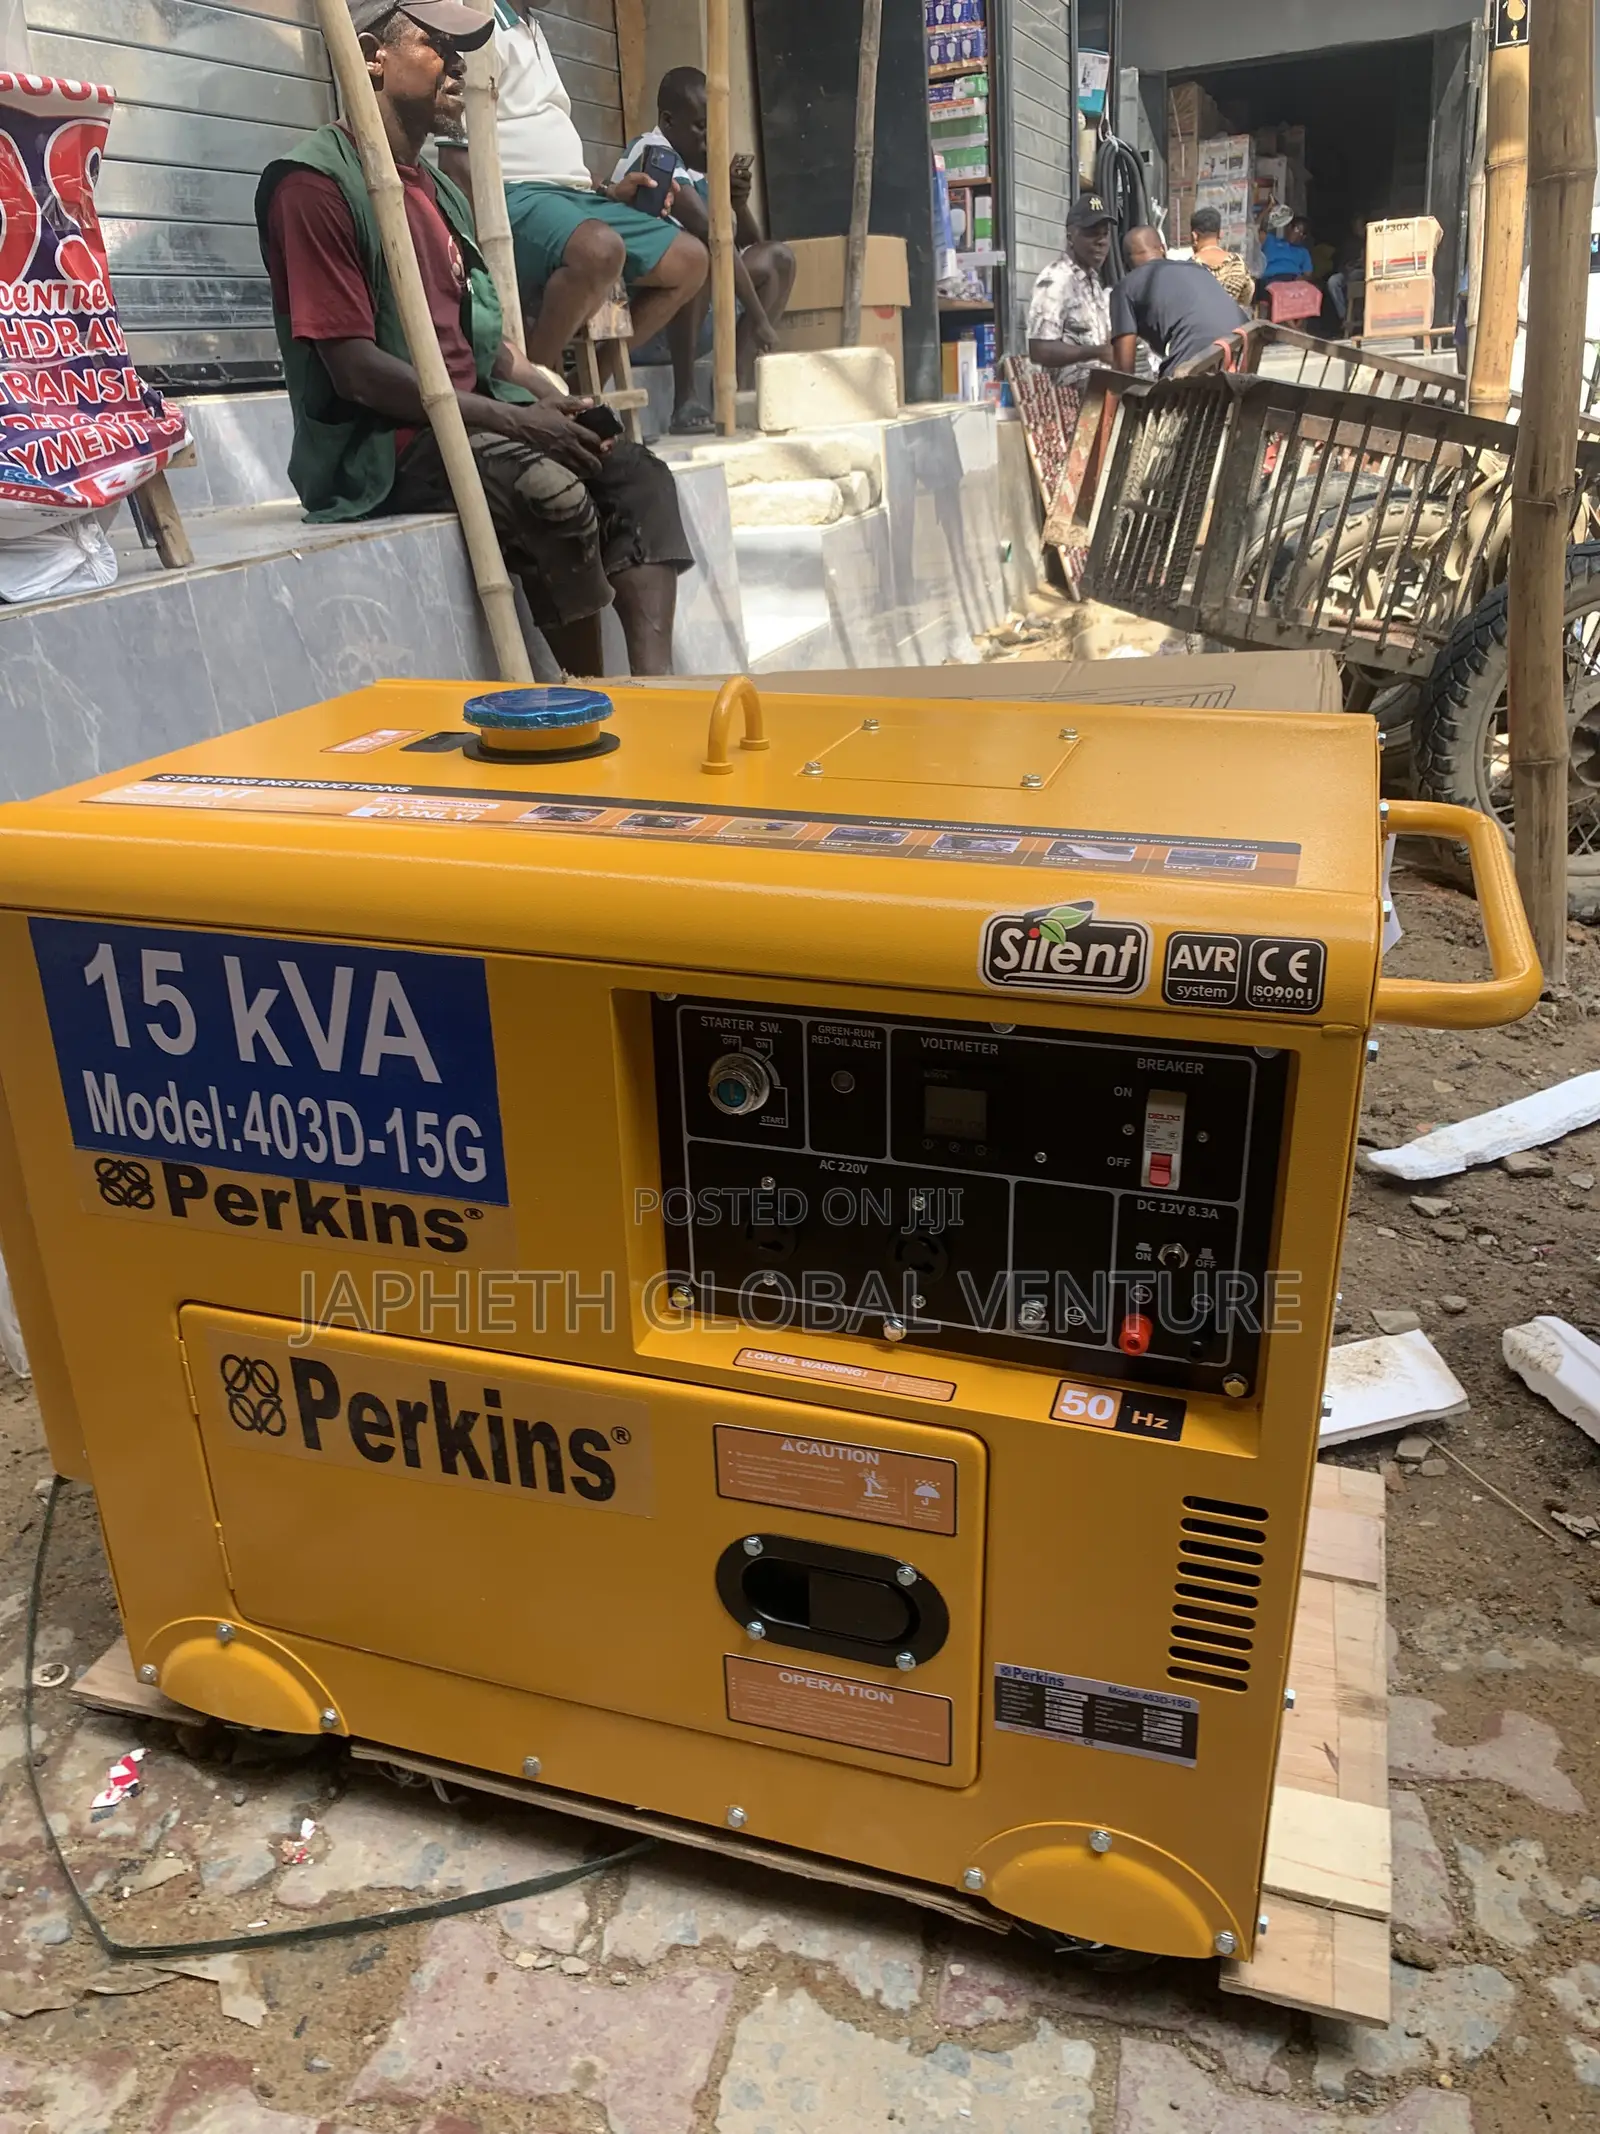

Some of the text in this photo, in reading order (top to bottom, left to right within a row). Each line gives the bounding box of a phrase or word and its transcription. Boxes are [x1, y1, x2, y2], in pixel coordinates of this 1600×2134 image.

[125, 784, 264, 798] SILENT
[158, 775, 412, 793] STARTING INSTRUCTIONS
[993, 926, 1138, 978] Silent
[1170, 944, 1236, 973] AVR
[1257, 946, 1311, 984] CE
[1175, 984, 1228, 1000] system
[1252, 984, 1313, 1001] ISO9001
[83, 942, 443, 1084] 15 kVA
[700, 1015, 783, 1035] STARTER SW.
[817, 1024, 876, 1039] GREEN-RUN
[722, 1036, 738, 1046] OFF
[755, 1040, 769, 1049] ON
[811, 1034, 883, 1050] RED-OIL ALERT
[920, 1036, 999, 1055] VOLTMETER
[1136, 1057, 1205, 1075] BREAKER
[1113, 1086, 1133, 1098] ON
[81, 1068, 488, 1184] Model:403D-15G
[760, 1115, 785, 1125] START
[819, 1159, 869, 1175] AC 220V
[1106, 1156, 1131, 1168] OFF
[1136, 1200, 1219, 1220] DC 12V 8.3A
[1135, 1251, 1152, 1261] ON
[1194, 1258, 1217, 1269] OFF
[746, 1351, 869, 1378] LOW OIL WARNING!
[1059, 1387, 1169, 1430] 50 Hz
[795, 1441, 880, 1466] CAUTION
[1012, 1667, 1065, 1687] Perkins
[778, 1671, 895, 1705] OPERATION
